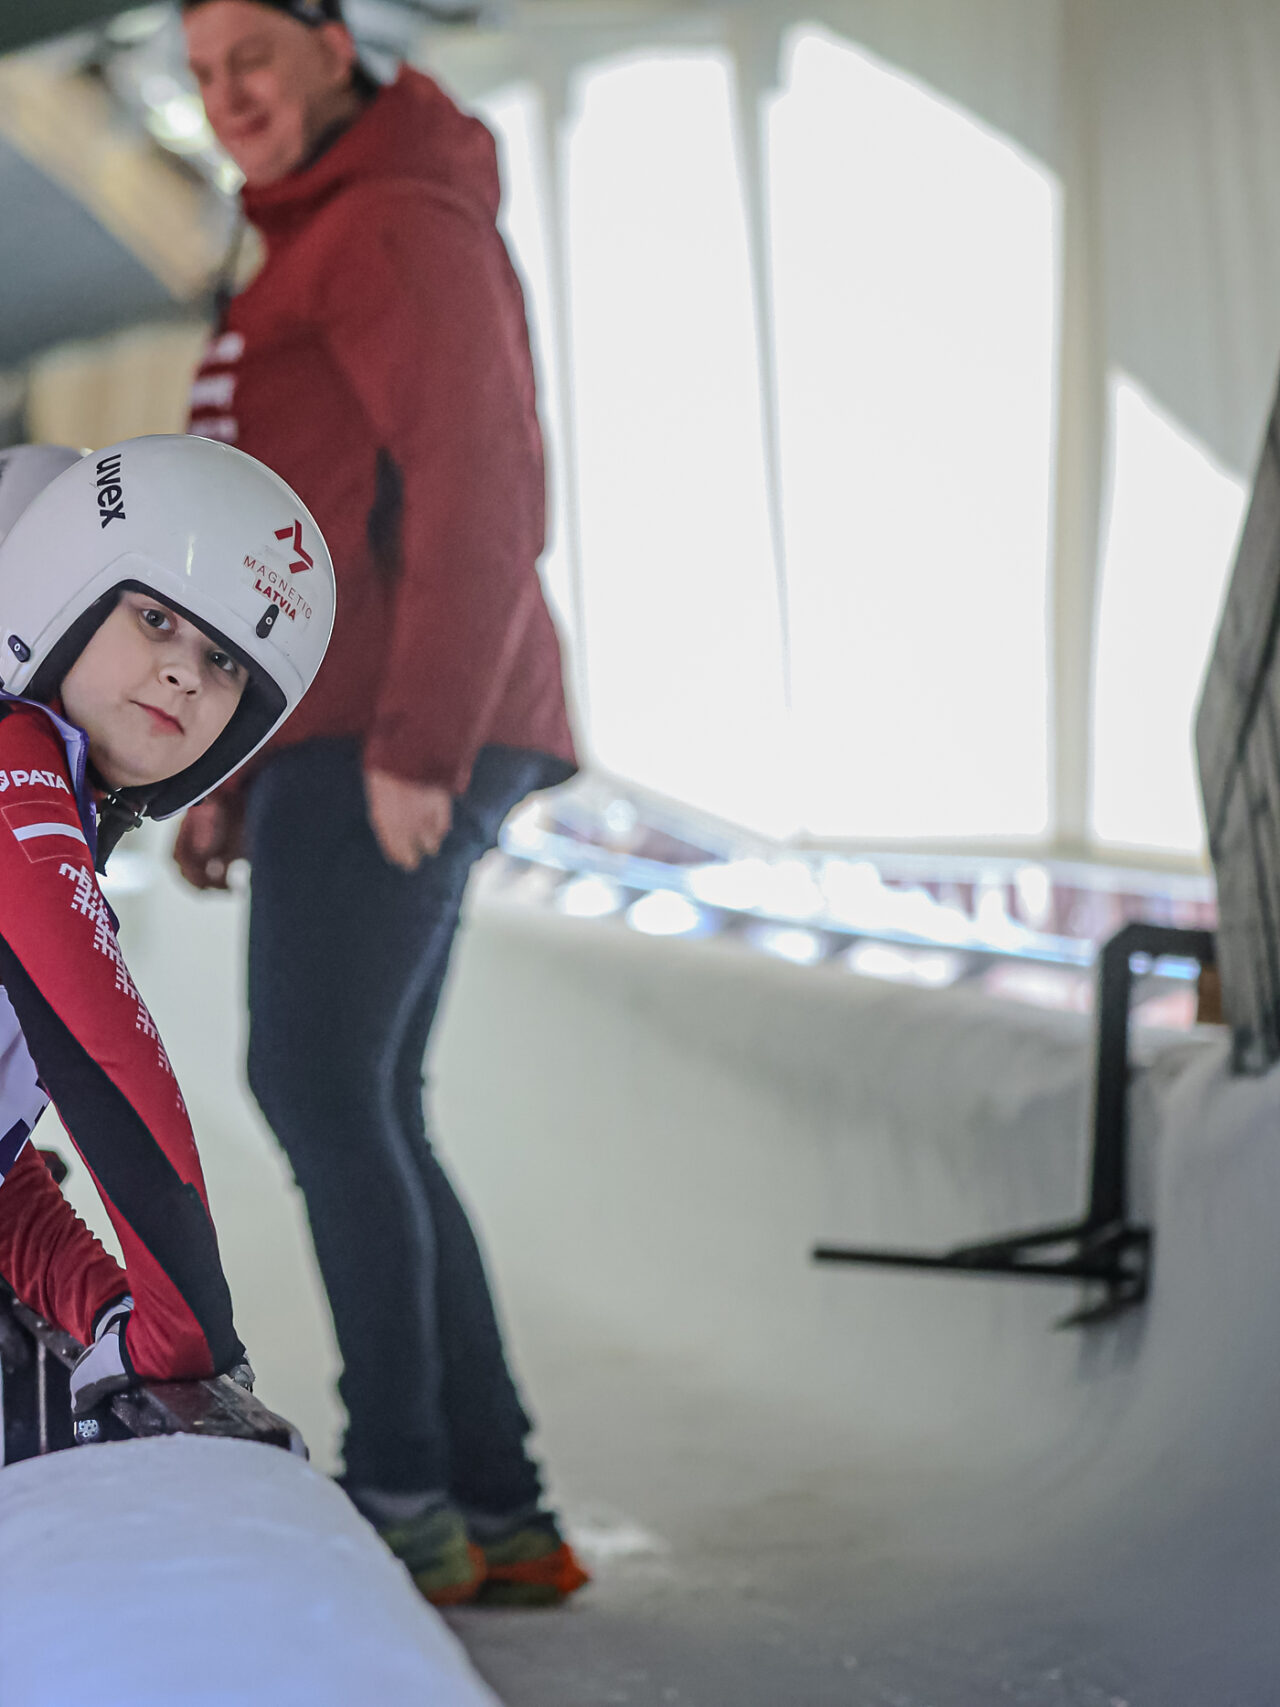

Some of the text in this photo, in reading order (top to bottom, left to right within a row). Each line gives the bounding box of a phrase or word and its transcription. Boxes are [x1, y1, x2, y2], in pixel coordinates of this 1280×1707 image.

[96, 453, 126, 529] uvex
[243, 555, 313, 619] MAGNETIC
[254, 579, 297, 621] LATVIA
[10, 769, 71, 795] PATA
